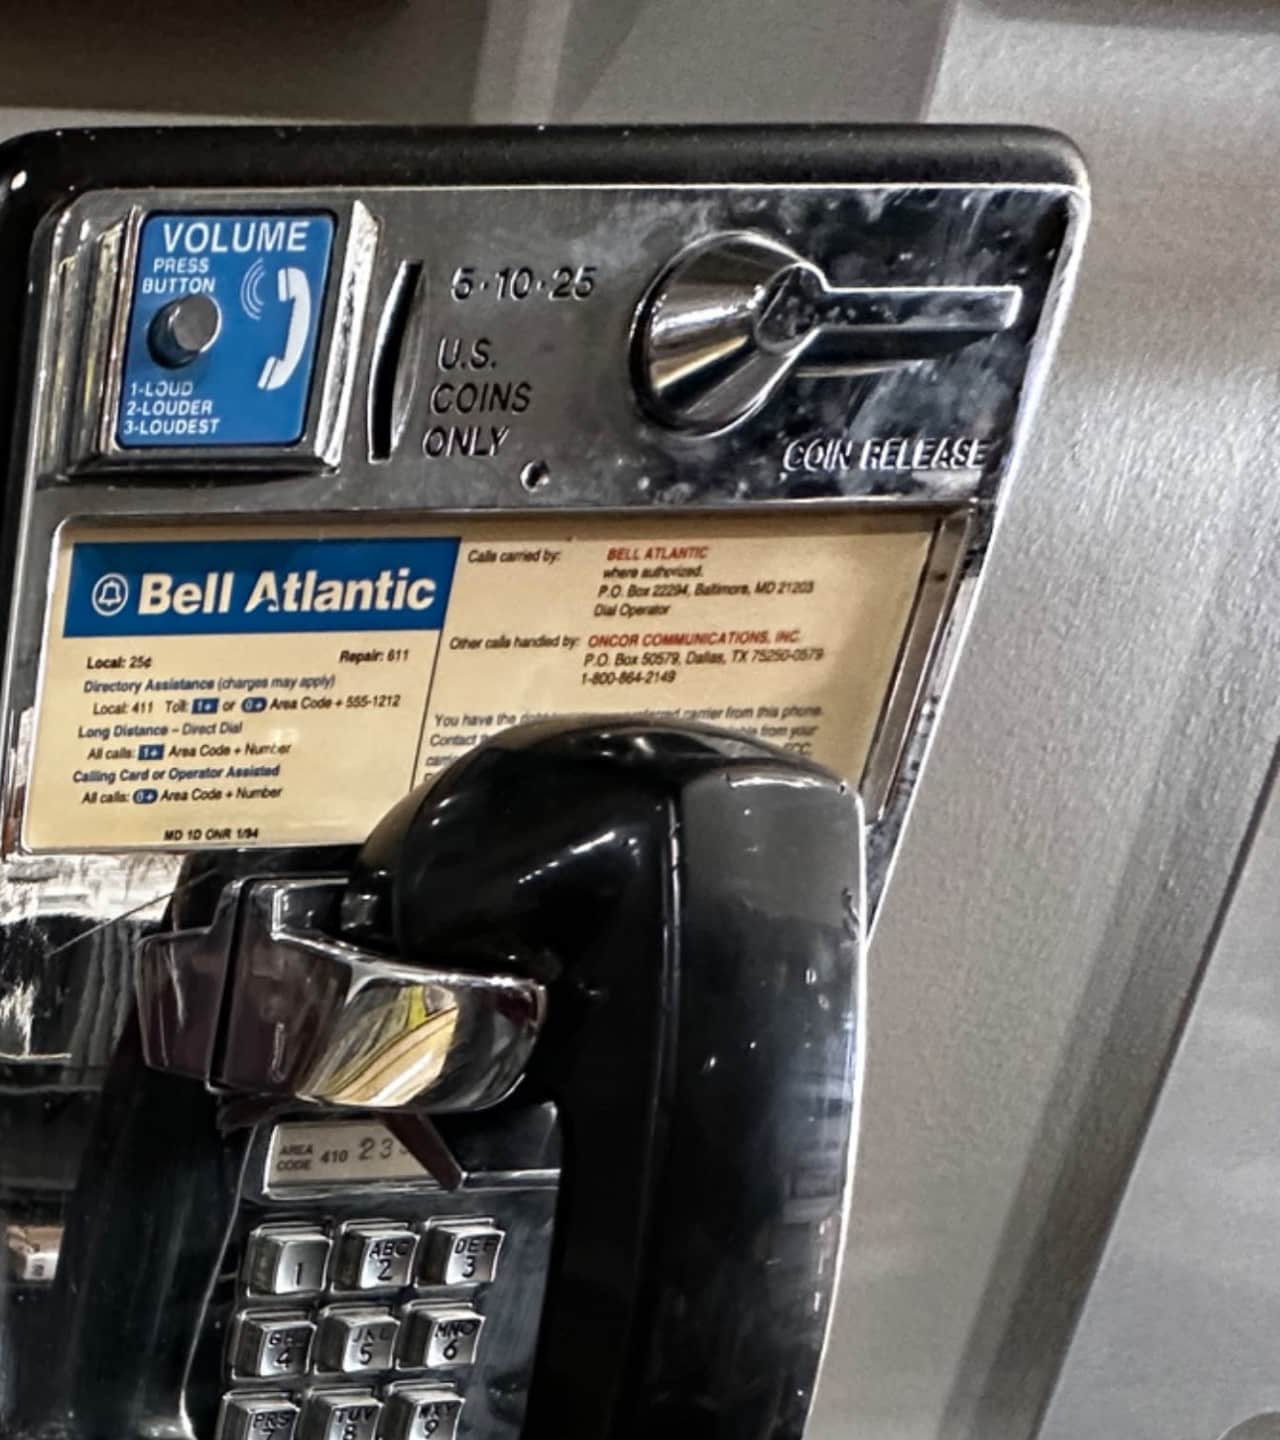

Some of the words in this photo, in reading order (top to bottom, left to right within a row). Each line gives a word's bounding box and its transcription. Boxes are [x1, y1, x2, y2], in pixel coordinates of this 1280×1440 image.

[163, 221, 310, 253] VOLUME
[153, 257, 209, 274] PRESS
[142, 277, 215, 295] BUTTON
[437, 337, 497, 372] U.S.
[131, 381, 193, 397] 1-LOUD
[430, 381, 533, 416] COINS
[127, 399, 214, 416] 2-LOUDER
[123, 418, 220, 434] 3-LOUDEST
[422, 425, 509, 460] ONLY
[783, 438, 853, 472] COIN
[859, 437, 990, 470] RELEASE
[607, 546, 640, 561] BELL
[644, 545, 709, 561] ATLANTIC
[138, 572, 234, 616] Bell
[244, 568, 436, 613] Atlantic
[594, 603, 616, 617] Dial
[619, 602, 671, 618] Operator
[588, 634, 639, 649] ONCOR
[86, 656, 126, 670] Local:
[339, 649, 383, 664] Repair:
[388, 649, 409, 661] 611
[84, 679, 141, 695] Directory
[145, 678, 214, 692] Assistance
[217, 677, 268, 692] (charges
[272, 678, 297, 690] may
[299, 674, 336, 690] apply)
[93, 702, 128, 716] Local:
[132, 702, 154, 714] 411
[270, 698, 297, 710] Area
[301, 697, 332, 710] Code
[346, 694, 401, 708] 555-1212
[73, 769, 115, 784] Calling
[119, 769, 149, 782] Card
[152, 771, 164, 781] or
[169, 767, 225, 782] Operator
[227, 765, 280, 778] Assisted
[279, 1144, 313, 1156] AREA
[276, 1158, 312, 1171] CODE
[320, 1150, 348, 1164] 410
[377, 1259, 392, 1281] 2
[443, 1337, 457, 1360] 6
